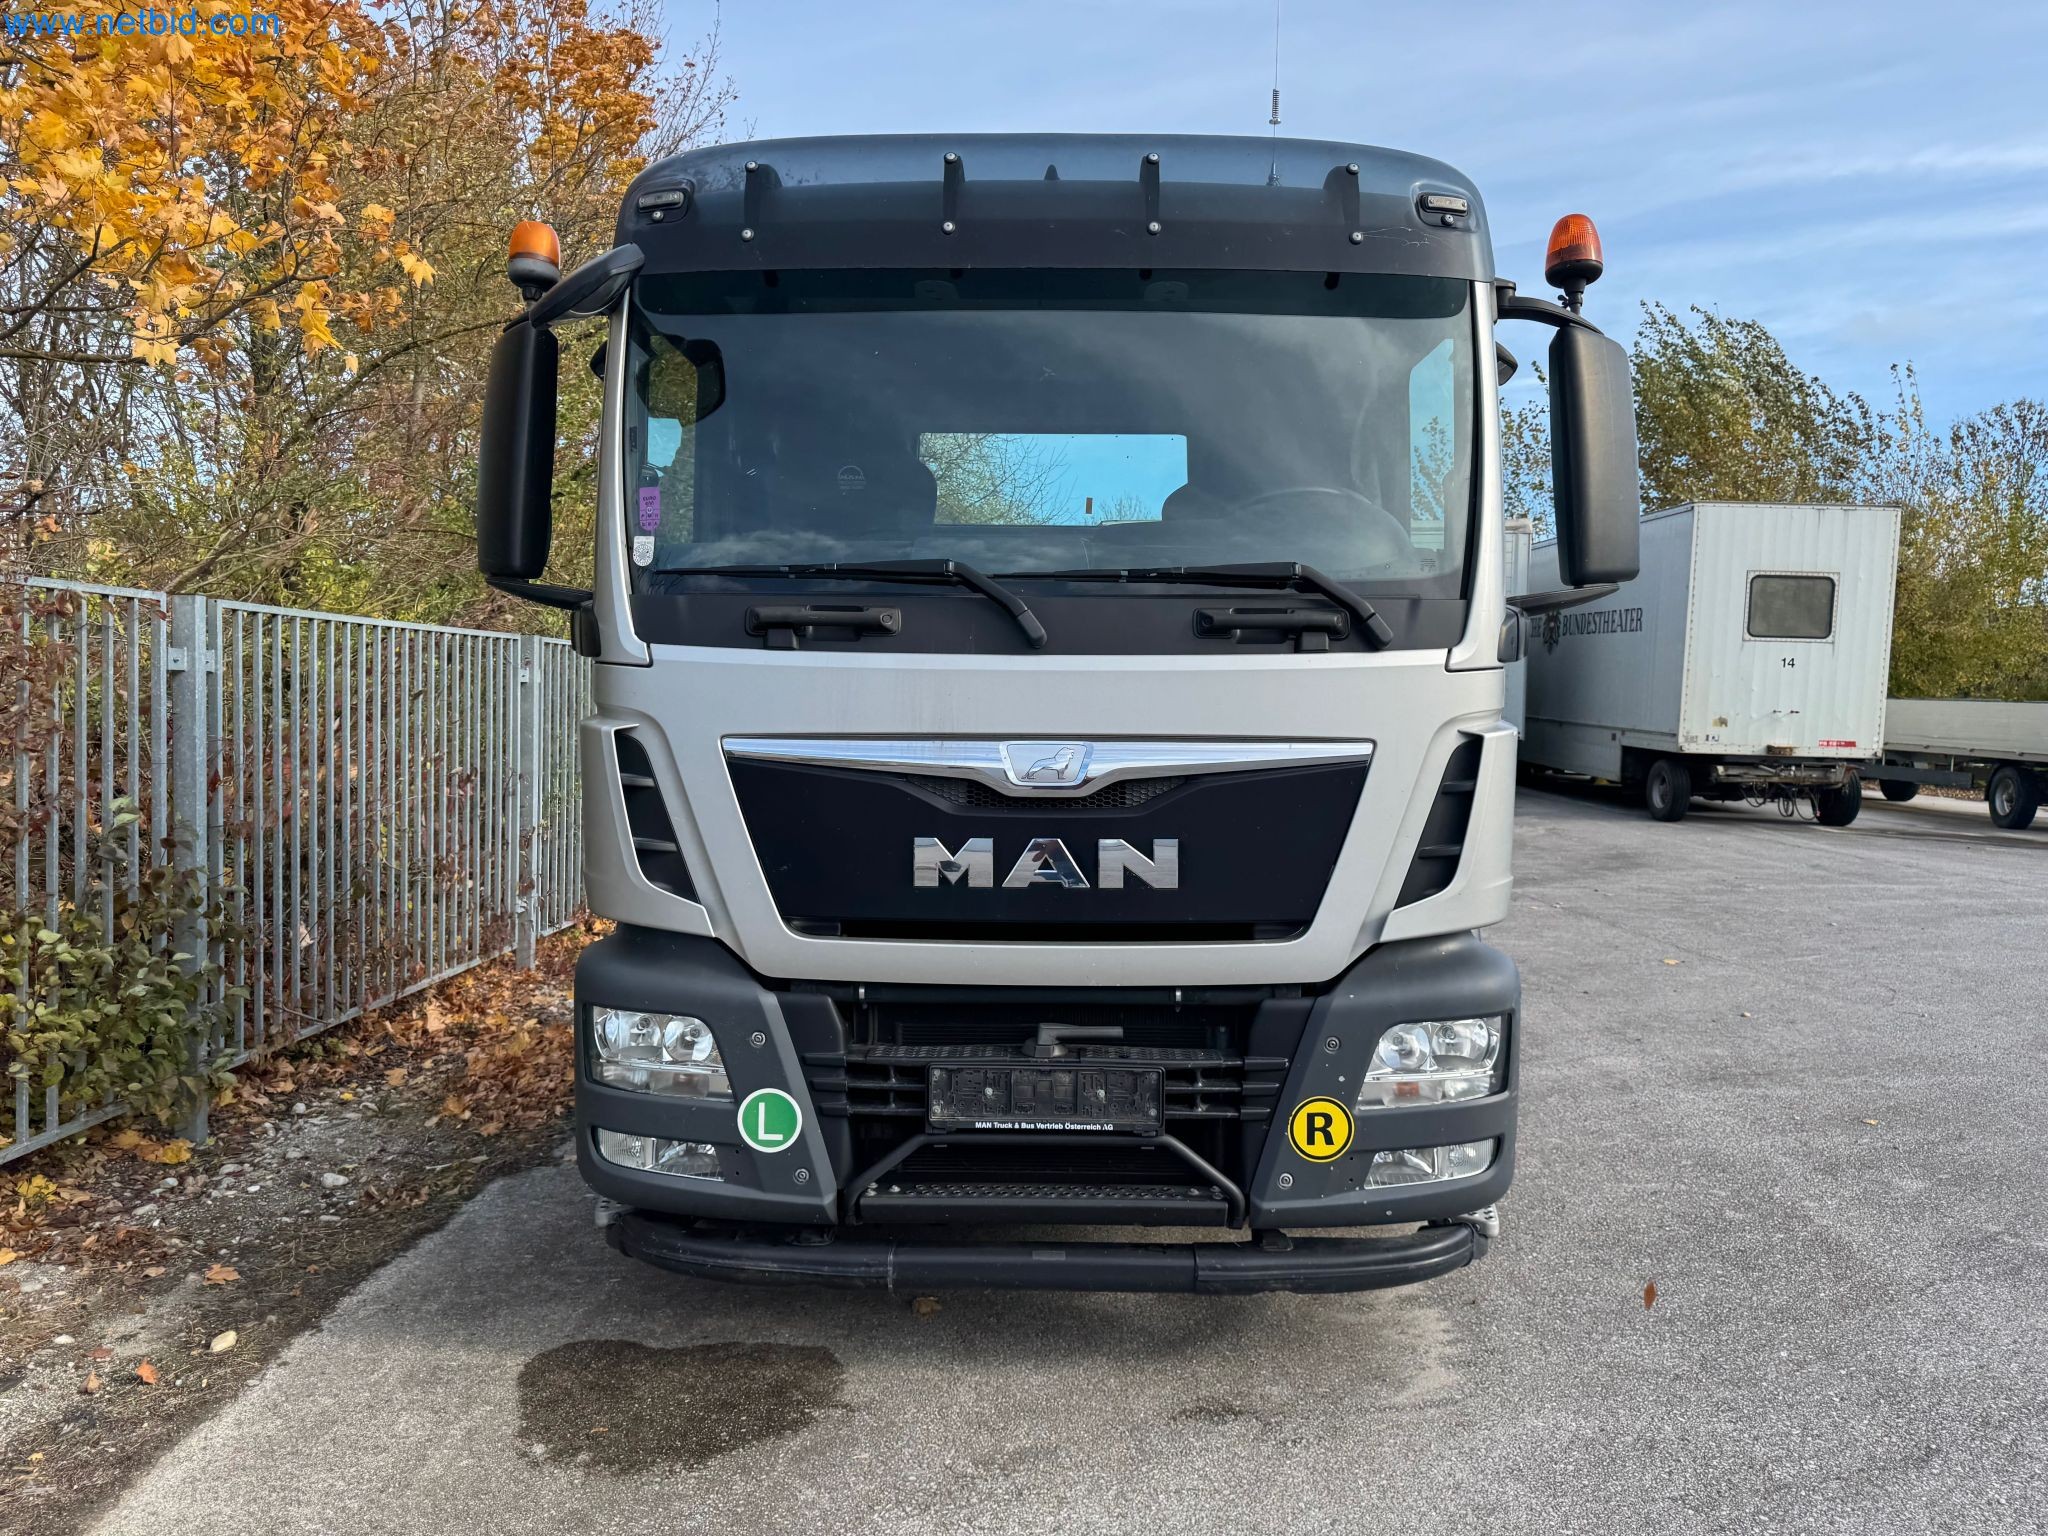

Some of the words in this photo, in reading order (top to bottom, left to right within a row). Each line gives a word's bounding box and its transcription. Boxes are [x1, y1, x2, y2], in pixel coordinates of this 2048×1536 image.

[1562, 607, 1643, 636] BUNDESTHEATER
[1781, 657, 1796, 669] 14
[913, 837, 1179, 889] MAN
[758, 1102, 784, 1141] L
[975, 1121, 992, 1129] MAN
[993, 1121, 1013, 1129] Truck
[1021, 1122, 1035, 1130] Bus
[1036, 1122, 1064, 1130] Vertrieb
[1064, 1121, 1101, 1131] Österreich
[1102, 1123, 1114, 1131] AG
[1306, 1112, 1335, 1146] R
